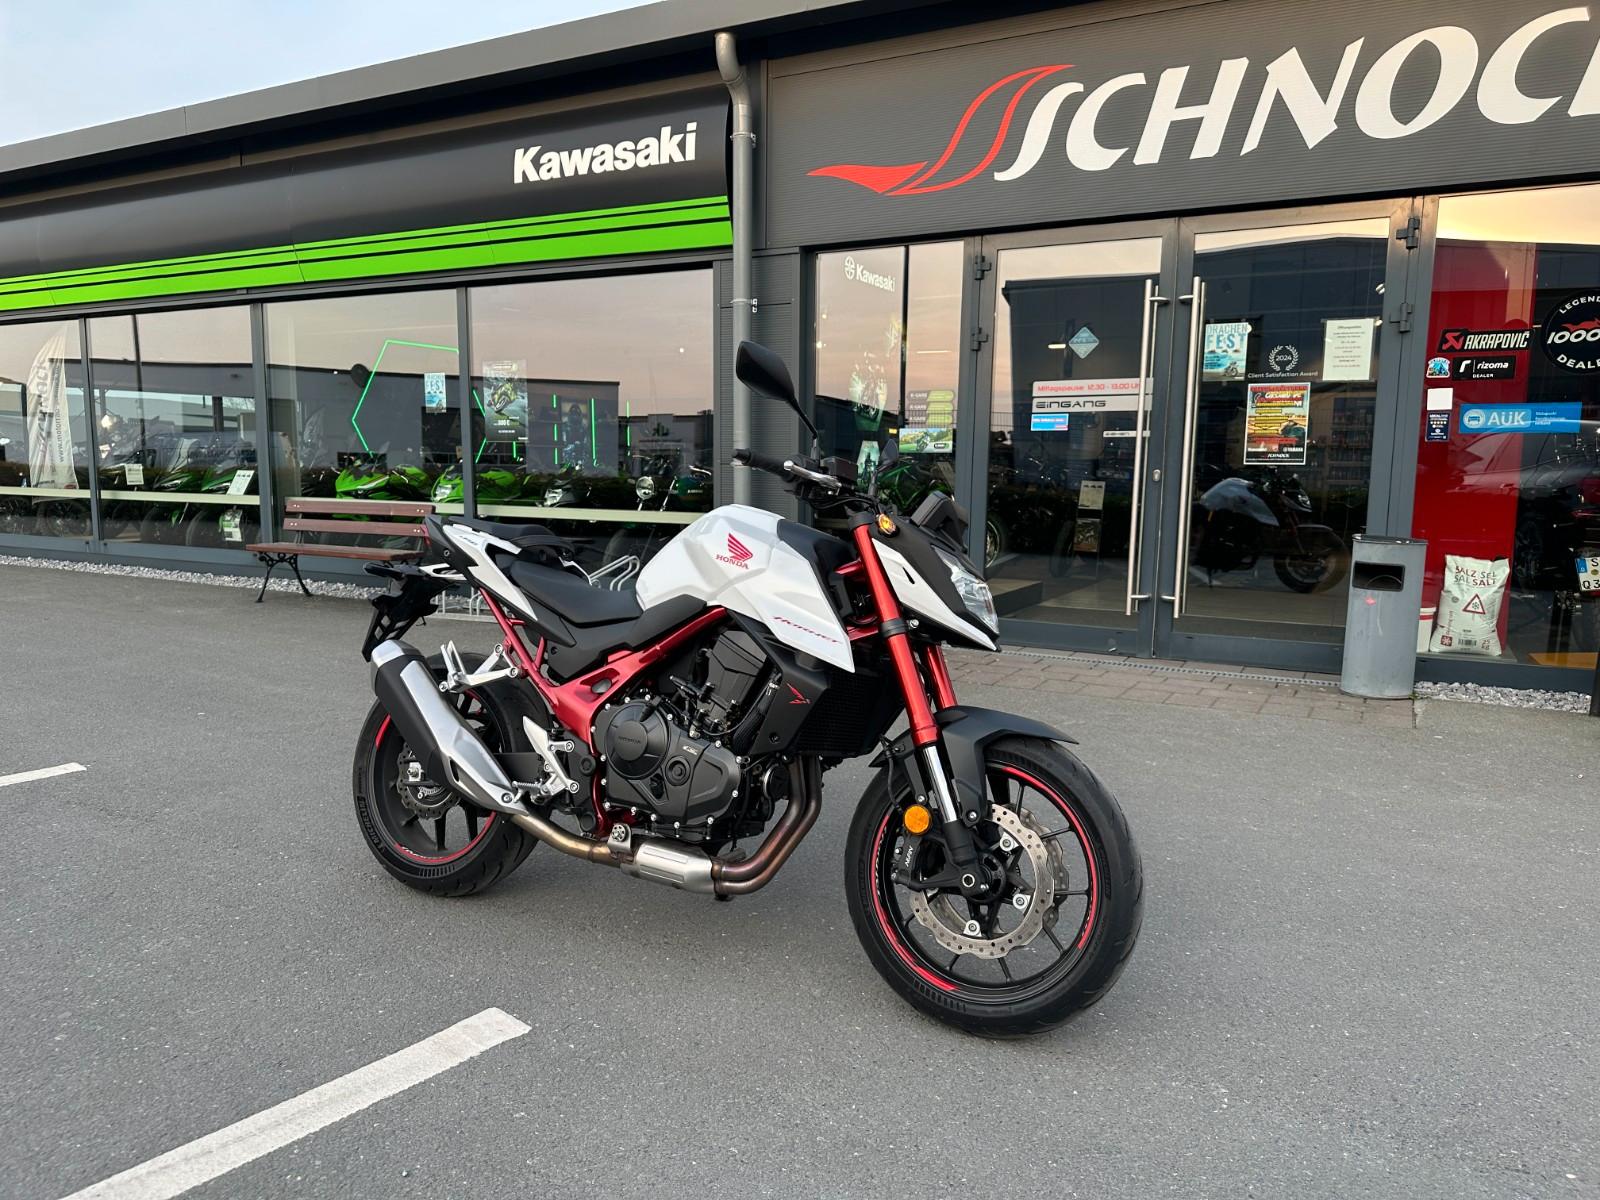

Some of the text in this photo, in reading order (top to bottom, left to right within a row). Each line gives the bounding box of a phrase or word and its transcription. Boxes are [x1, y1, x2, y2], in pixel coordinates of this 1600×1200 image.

[513, 121, 698, 184] Kawasaki
[856, 264, 896, 292] Kawasaki
[1206, 323, 1248, 335] DRACHEN
[1206, 333, 1246, 349] FEST
[1477, 361, 1509, 370] rizoma
[715, 553, 749, 570] HONDA
[1455, 565, 1496, 579] SALZ SEL
[1454, 574, 1496, 587] SAL SALT
